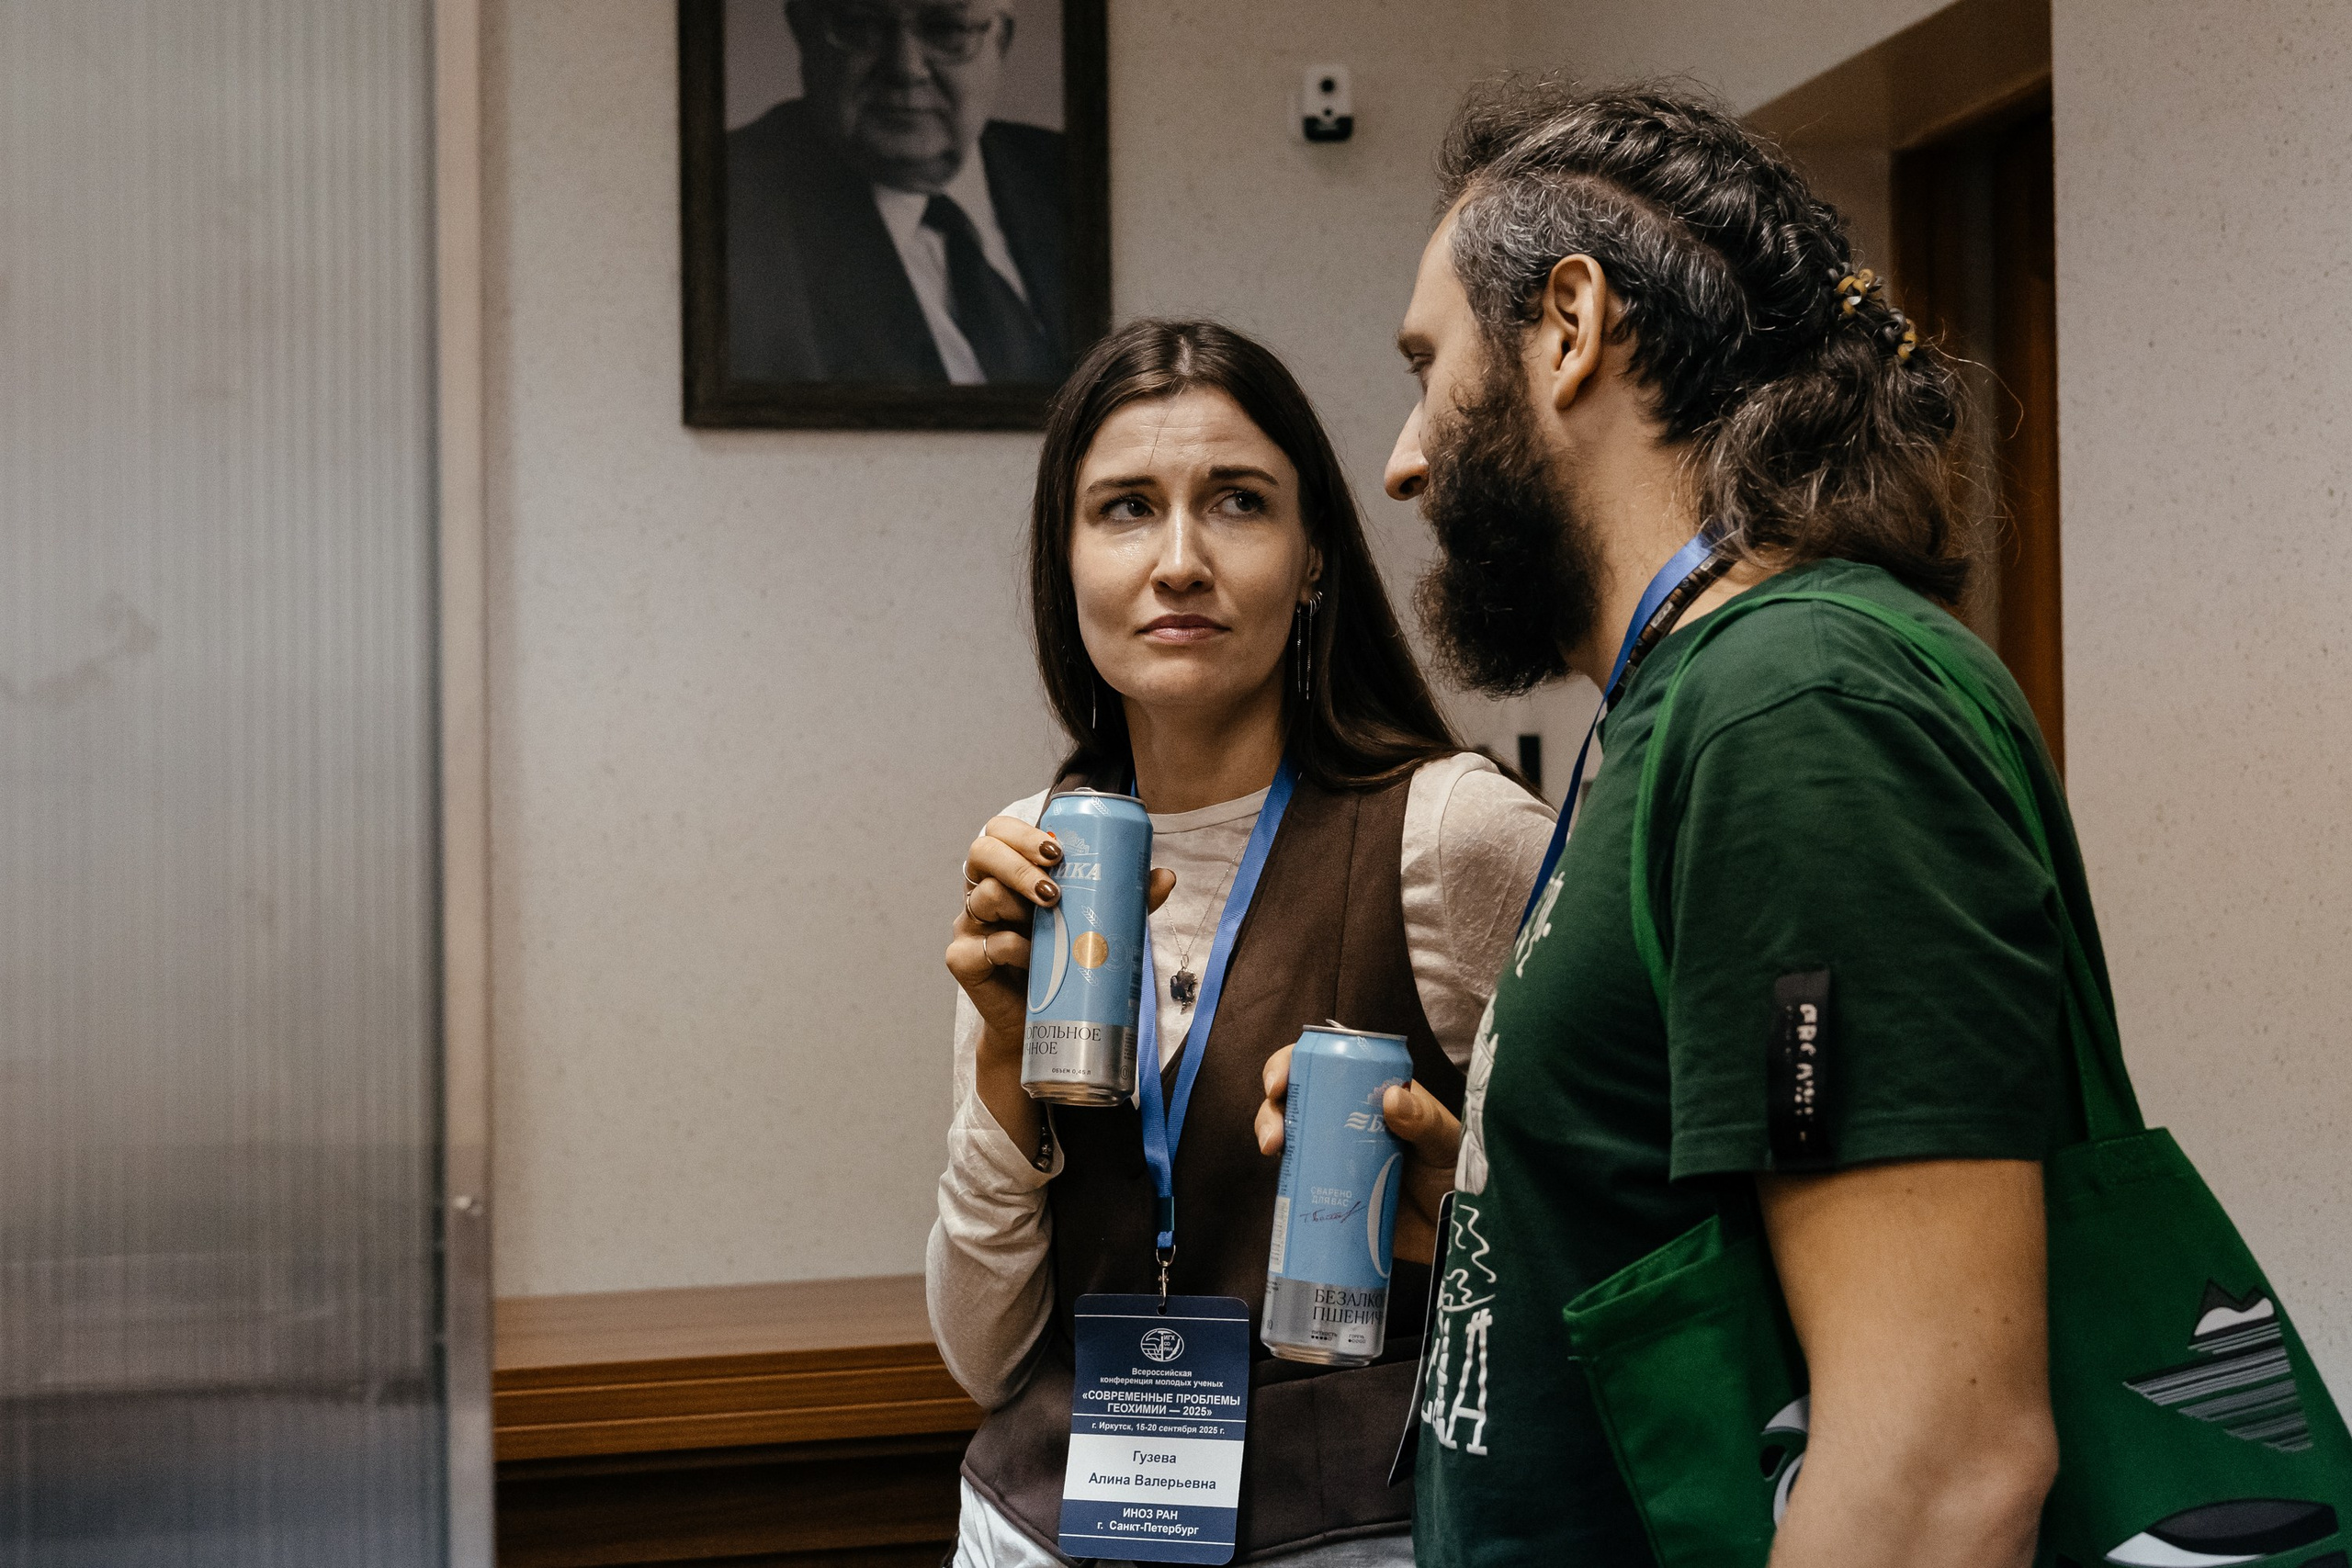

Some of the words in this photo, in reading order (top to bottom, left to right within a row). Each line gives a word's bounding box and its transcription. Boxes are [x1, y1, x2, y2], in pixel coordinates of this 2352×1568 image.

[1052, 862, 1102, 881] ИКА
[1310, 1186, 1352, 1199] СВАРЕНО
[1311, 1195, 1330, 1205] ДЛЯ
[1330, 1197, 1349, 1207] ВАС
[1131, 1367, 1193, 1378] Всероссийская
[1100, 1376, 1153, 1386] конференция
[1155, 1379, 1192, 1387] молодых
[1193, 1380, 1224, 1389] ученых
[1081, 1390, 1173, 1404] «СОВРЕМЕННЫЕ
[1175, 1393, 1240, 1406] ПРОБЛЕМЫ
[1107, 1403, 1167, 1415] ГЕОХИМИИ
[1182, 1405, 1213, 1416] 2025»
[1099, 1422, 1134, 1431] Иркутск,
[1136, 1423, 1158, 1432] 15-20
[1159, 1425, 1197, 1434] сентября
[1198, 1426, 1218, 1434] 2025
[1132, 1450, 1177, 1465] Гузева
[1088, 1472, 1131, 1485] Алина
[1134, 1474, 1216, 1490] Валерьевна
[1123, 1507, 1153, 1519] ИНОЗ
[1156, 1509, 1179, 1520] РАН
[1097, 1521, 1103, 1529] г.
[1109, 1520, 1200, 1537] Санкт-Петербург
